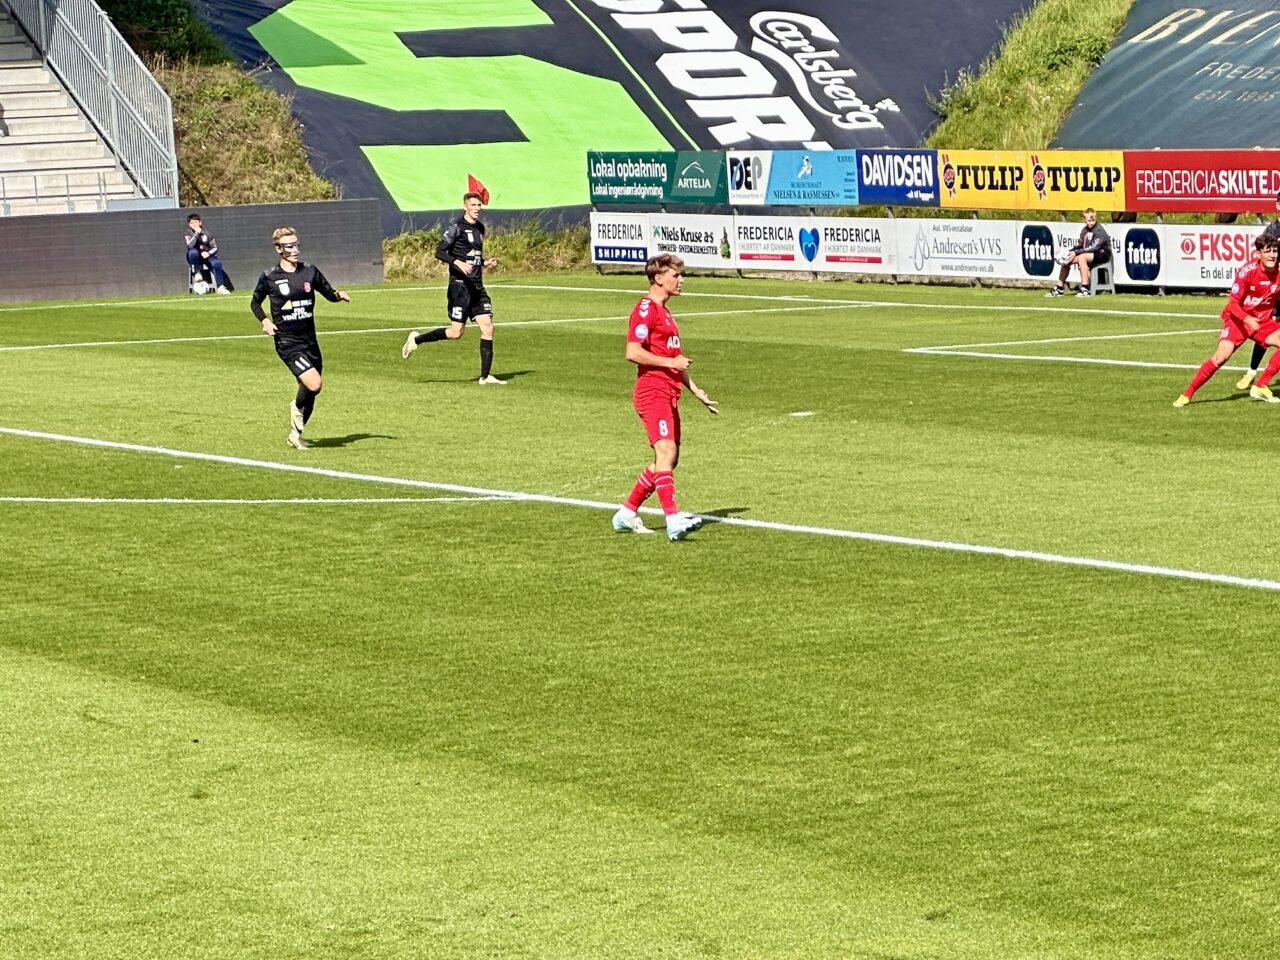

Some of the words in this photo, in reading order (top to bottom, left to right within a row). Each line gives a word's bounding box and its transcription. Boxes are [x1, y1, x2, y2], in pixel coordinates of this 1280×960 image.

[750, 11, 884, 129] Carlsberg
[591, 159, 615, 177] Lokal
[617, 159, 667, 182] opbakning
[862, 154, 933, 187] DAVIDSEN
[957, 165, 1024, 190] TULIP
[1047, 166, 1121, 192] TULIP
[678, 178, 711, 188] ARTELIA
[597, 223, 643, 241] FREDERICIA
[661, 226, 679, 242] Niels
[680, 227, 702, 243] Kruse
[738, 226, 794, 241] FREDERICIA
[824, 227, 881, 243] FREDERICIA
[598, 248, 645, 260] SHIPPING
[932, 237, 978, 255] Andresen's
[979, 237, 1002, 256] VVS
[1200, 267, 1211, 279] En
[1212, 267, 1224, 279] del
[1225, 267, 1235, 279] af
[451, 306, 463, 319] 15
[666, 335, 681, 349] AD
[658, 419, 669, 437] 8
